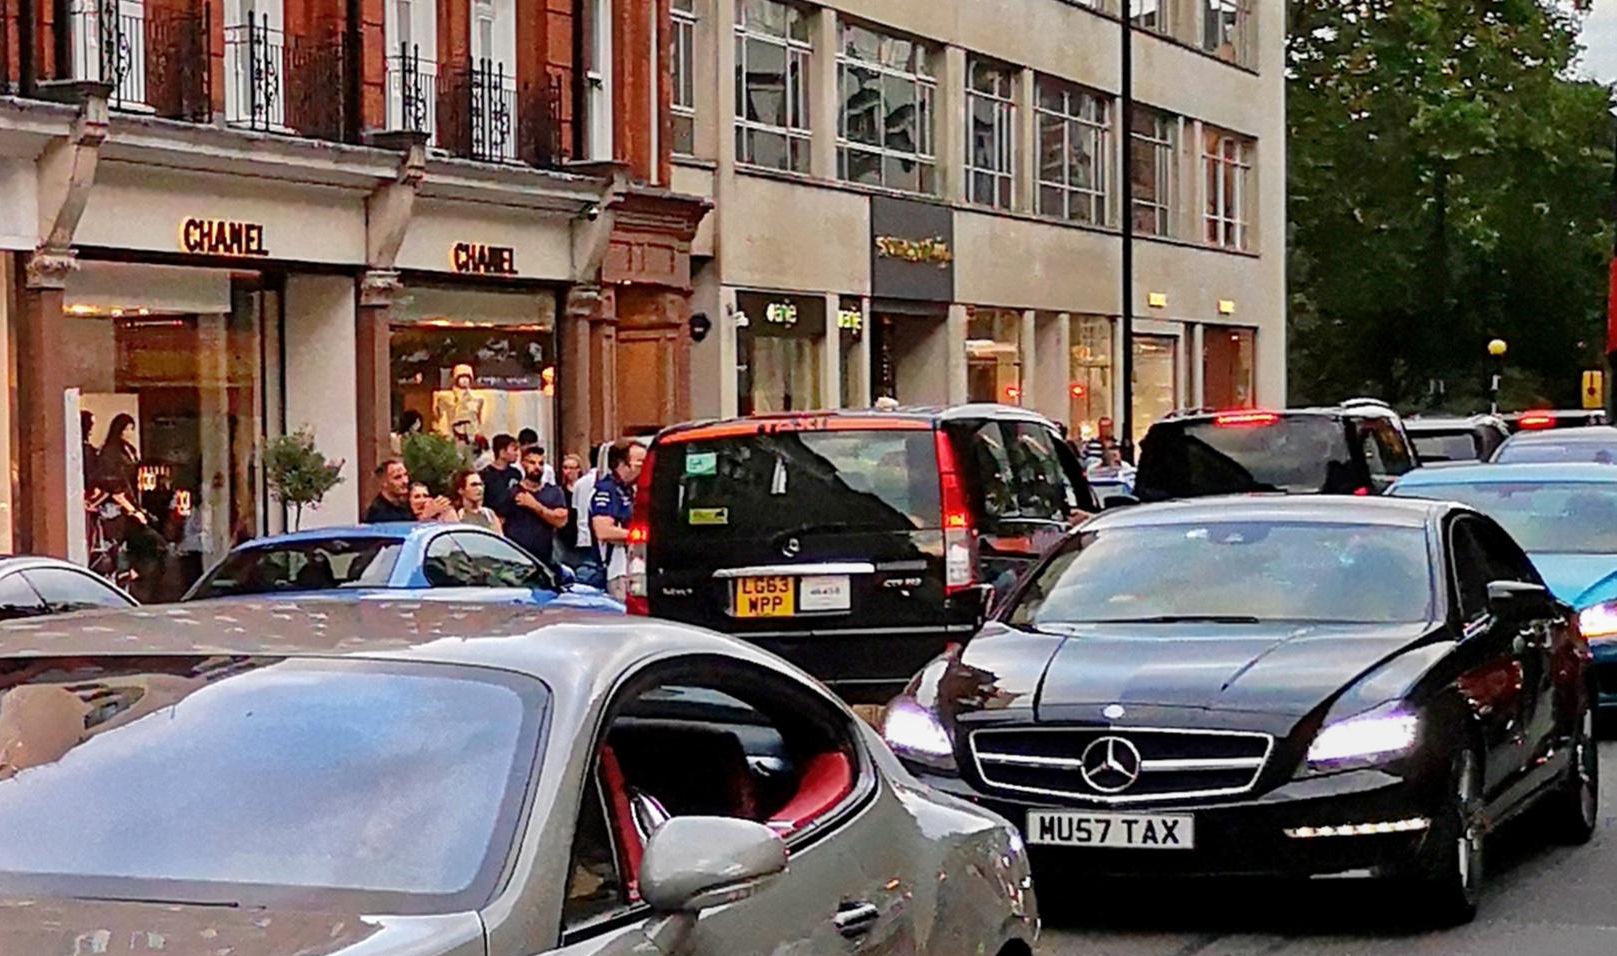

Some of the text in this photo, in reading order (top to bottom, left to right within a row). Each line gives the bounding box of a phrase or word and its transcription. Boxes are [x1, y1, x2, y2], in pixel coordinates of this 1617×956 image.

[184, 218, 269, 256] CHANEL
[454, 243, 518, 275] CHANEL
[742, 575, 789, 595] LG63
[749, 596, 784, 614] WPP
[1122, 820, 1179, 845] TAX
